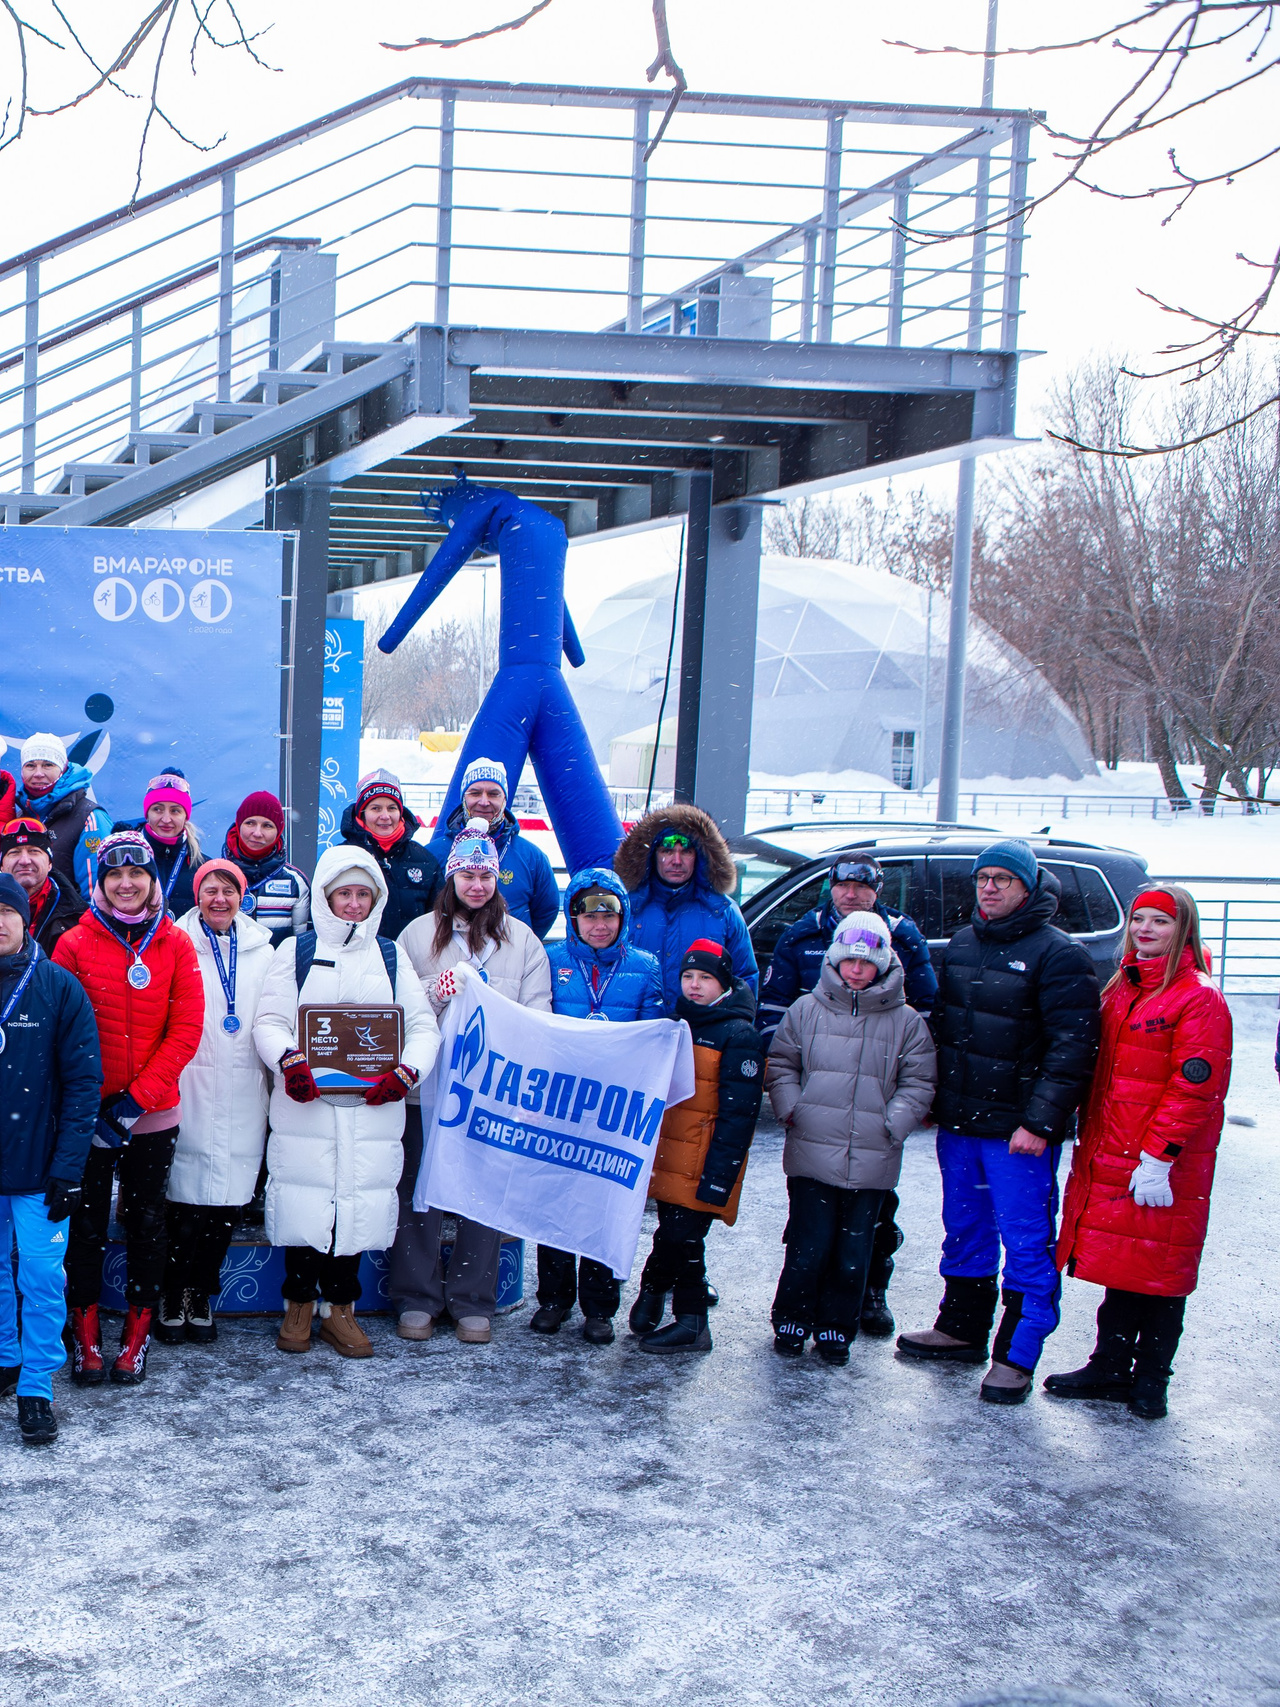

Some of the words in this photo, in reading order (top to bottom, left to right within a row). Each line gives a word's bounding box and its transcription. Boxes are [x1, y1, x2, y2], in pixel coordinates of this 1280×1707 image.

[93, 556, 233, 576] ВМАРАФОНЕ
[194, 626, 214, 634] 2020
[363, 786, 400, 801] RUSSIA
[317, 1017, 332, 1036] 3
[310, 1036, 339, 1044] МЕСТО
[478, 1050, 666, 1147] ГАЗПРОМ
[474, 1116, 637, 1180] ЭНЕРГОХОЛДИНГ
[779, 1323, 804, 1336] allo
[819, 1330, 845, 1343] allo
